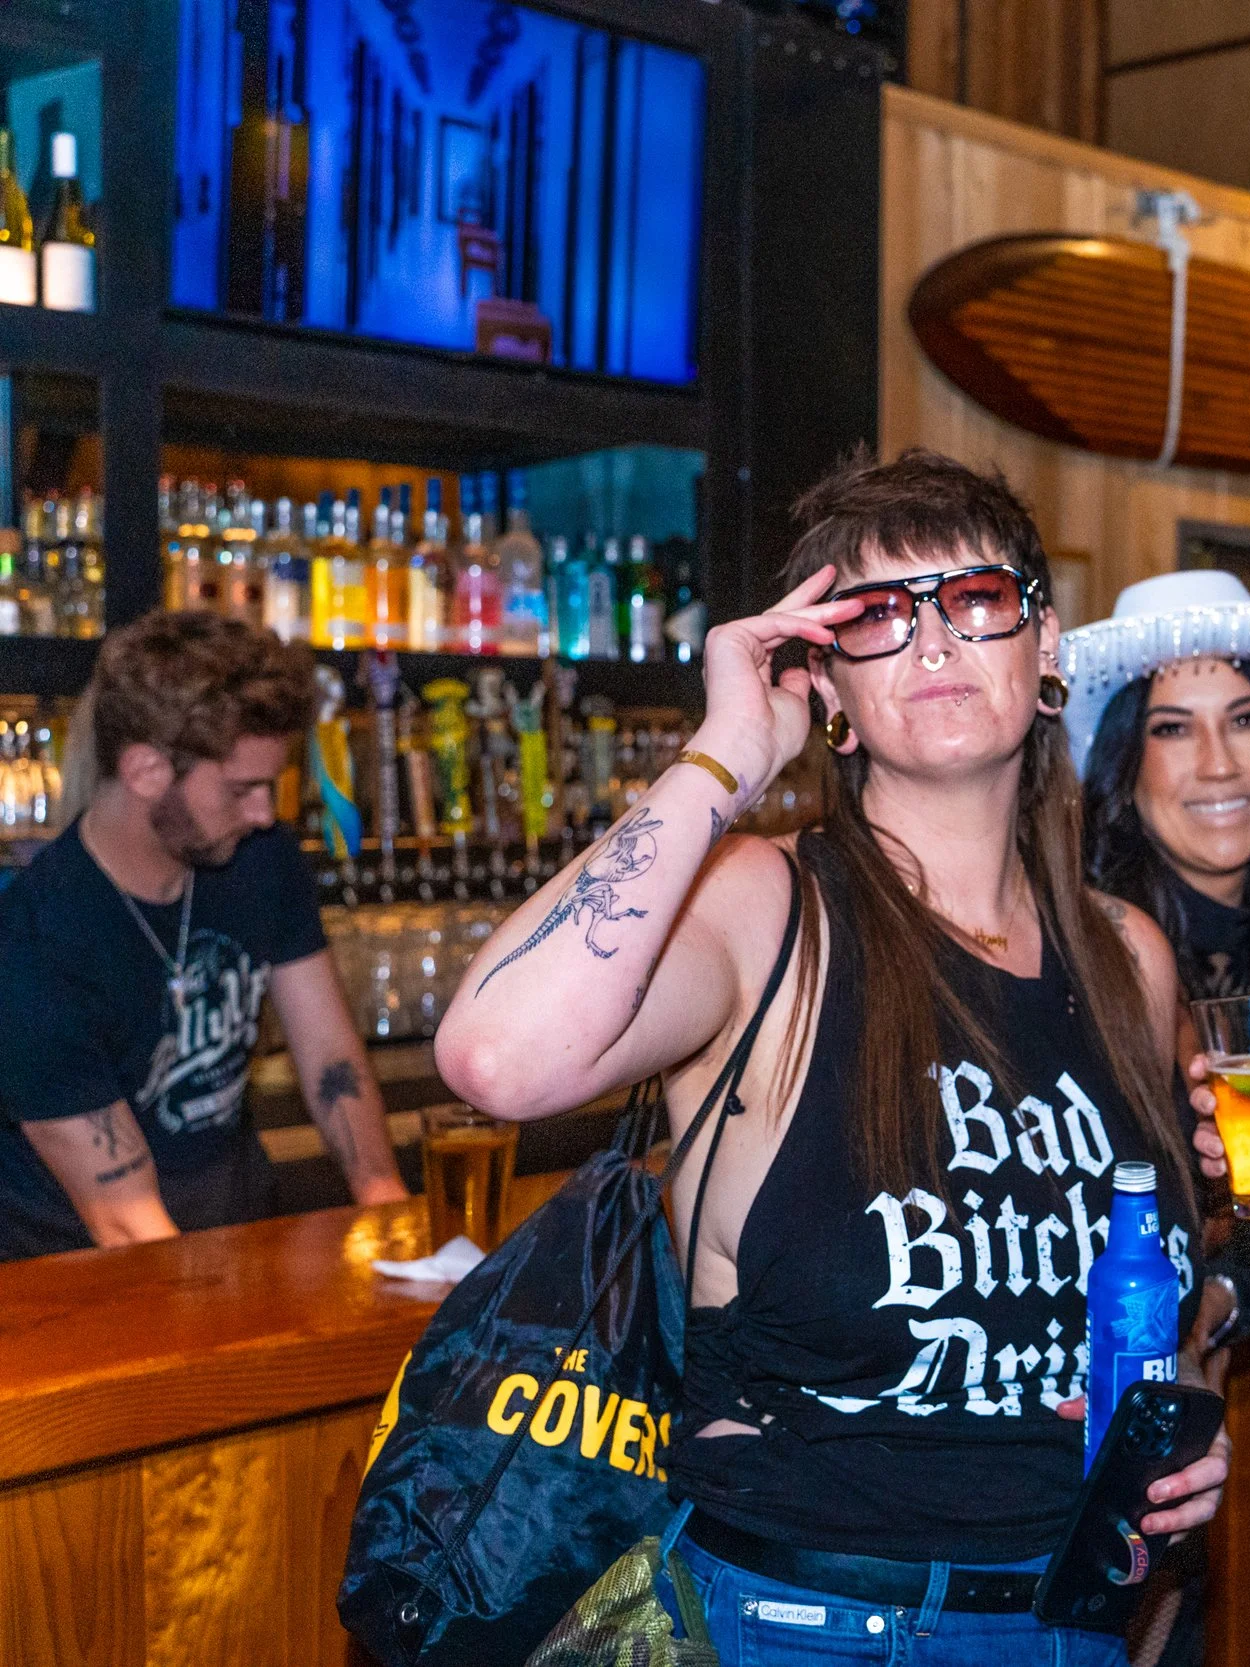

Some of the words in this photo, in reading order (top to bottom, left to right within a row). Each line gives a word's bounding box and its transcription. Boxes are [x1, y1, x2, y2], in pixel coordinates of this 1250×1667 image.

[926, 1060, 1114, 1178] Bad
[865, 1181, 1193, 1310] Bitchs
[1143, 1353, 1177, 1382] BU
[761, 1605, 794, 1619] Calvin
[797, 1610, 823, 1621] Klein
